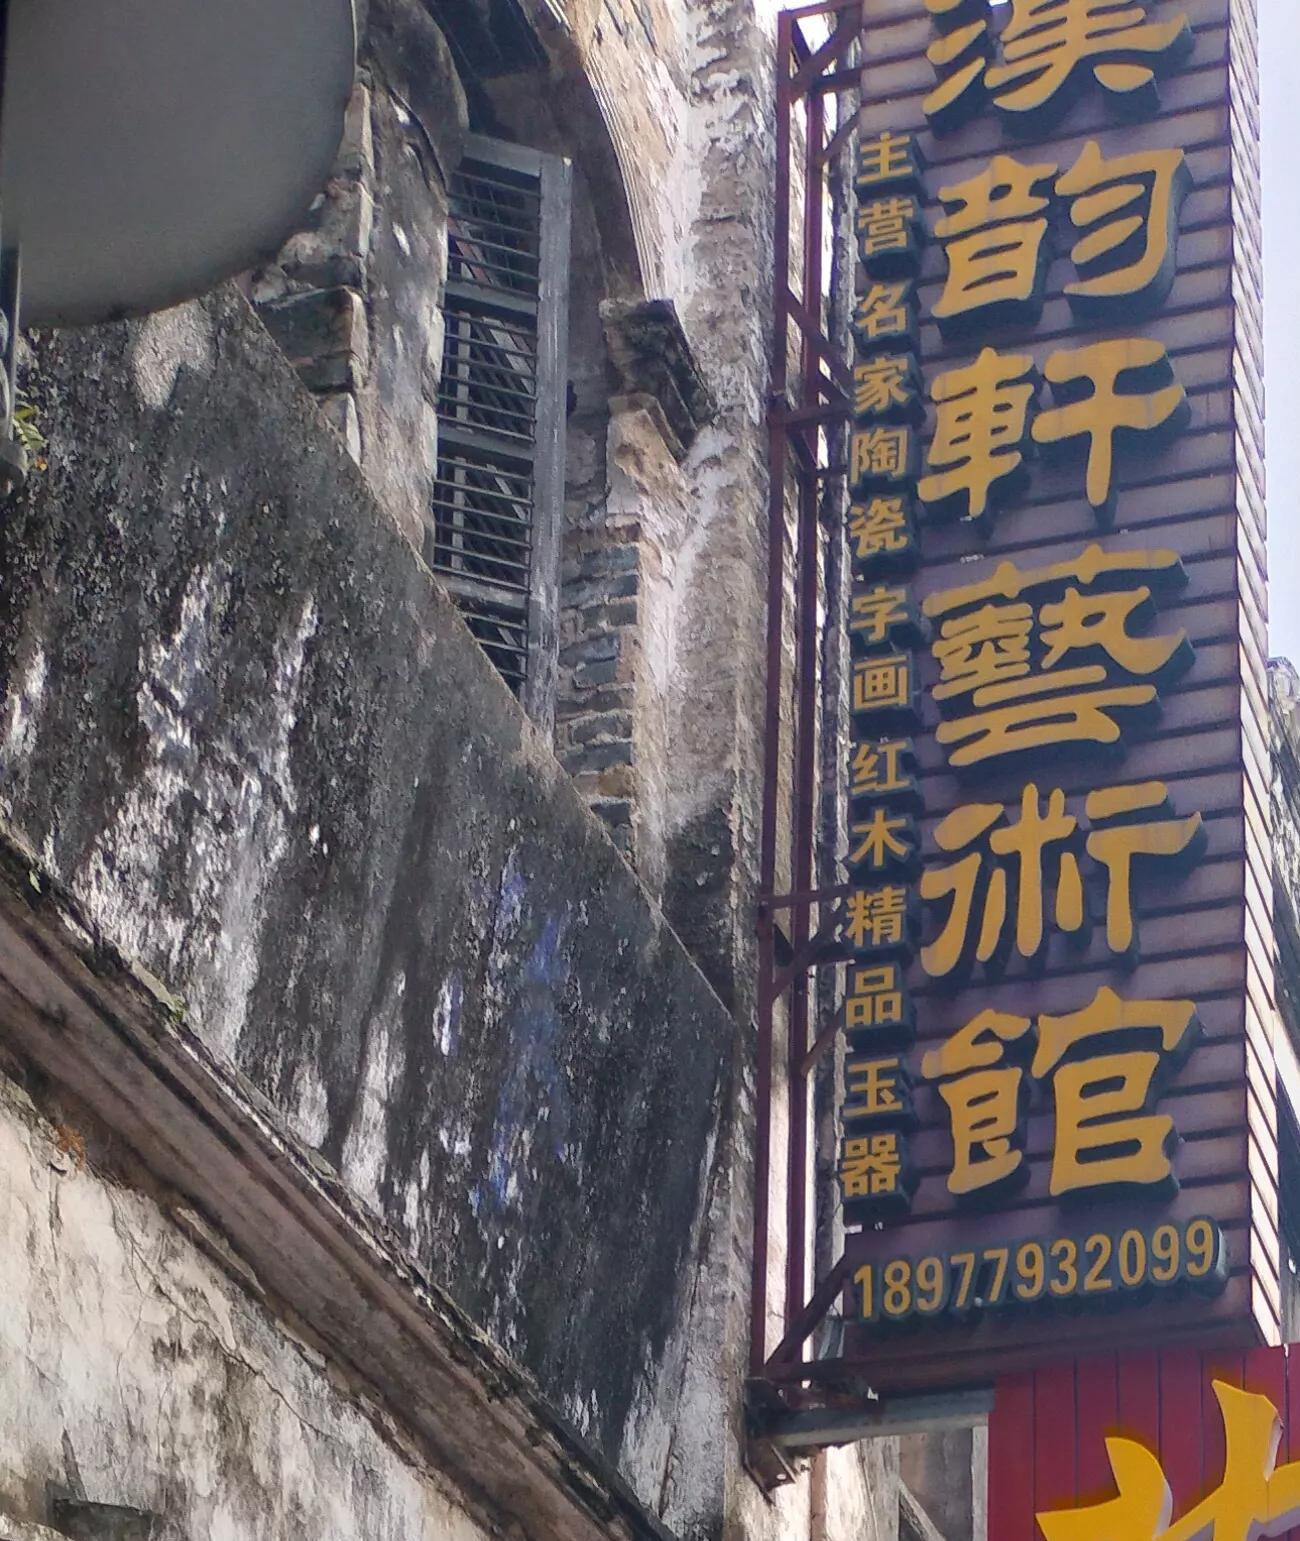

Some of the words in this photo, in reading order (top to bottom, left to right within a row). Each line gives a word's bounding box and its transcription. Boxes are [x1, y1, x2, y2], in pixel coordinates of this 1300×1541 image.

[841, 133, 913, 1197] 主营名家陶瓷字画红木精品玉器
[853, 1220, 1215, 1319] 18977932099
